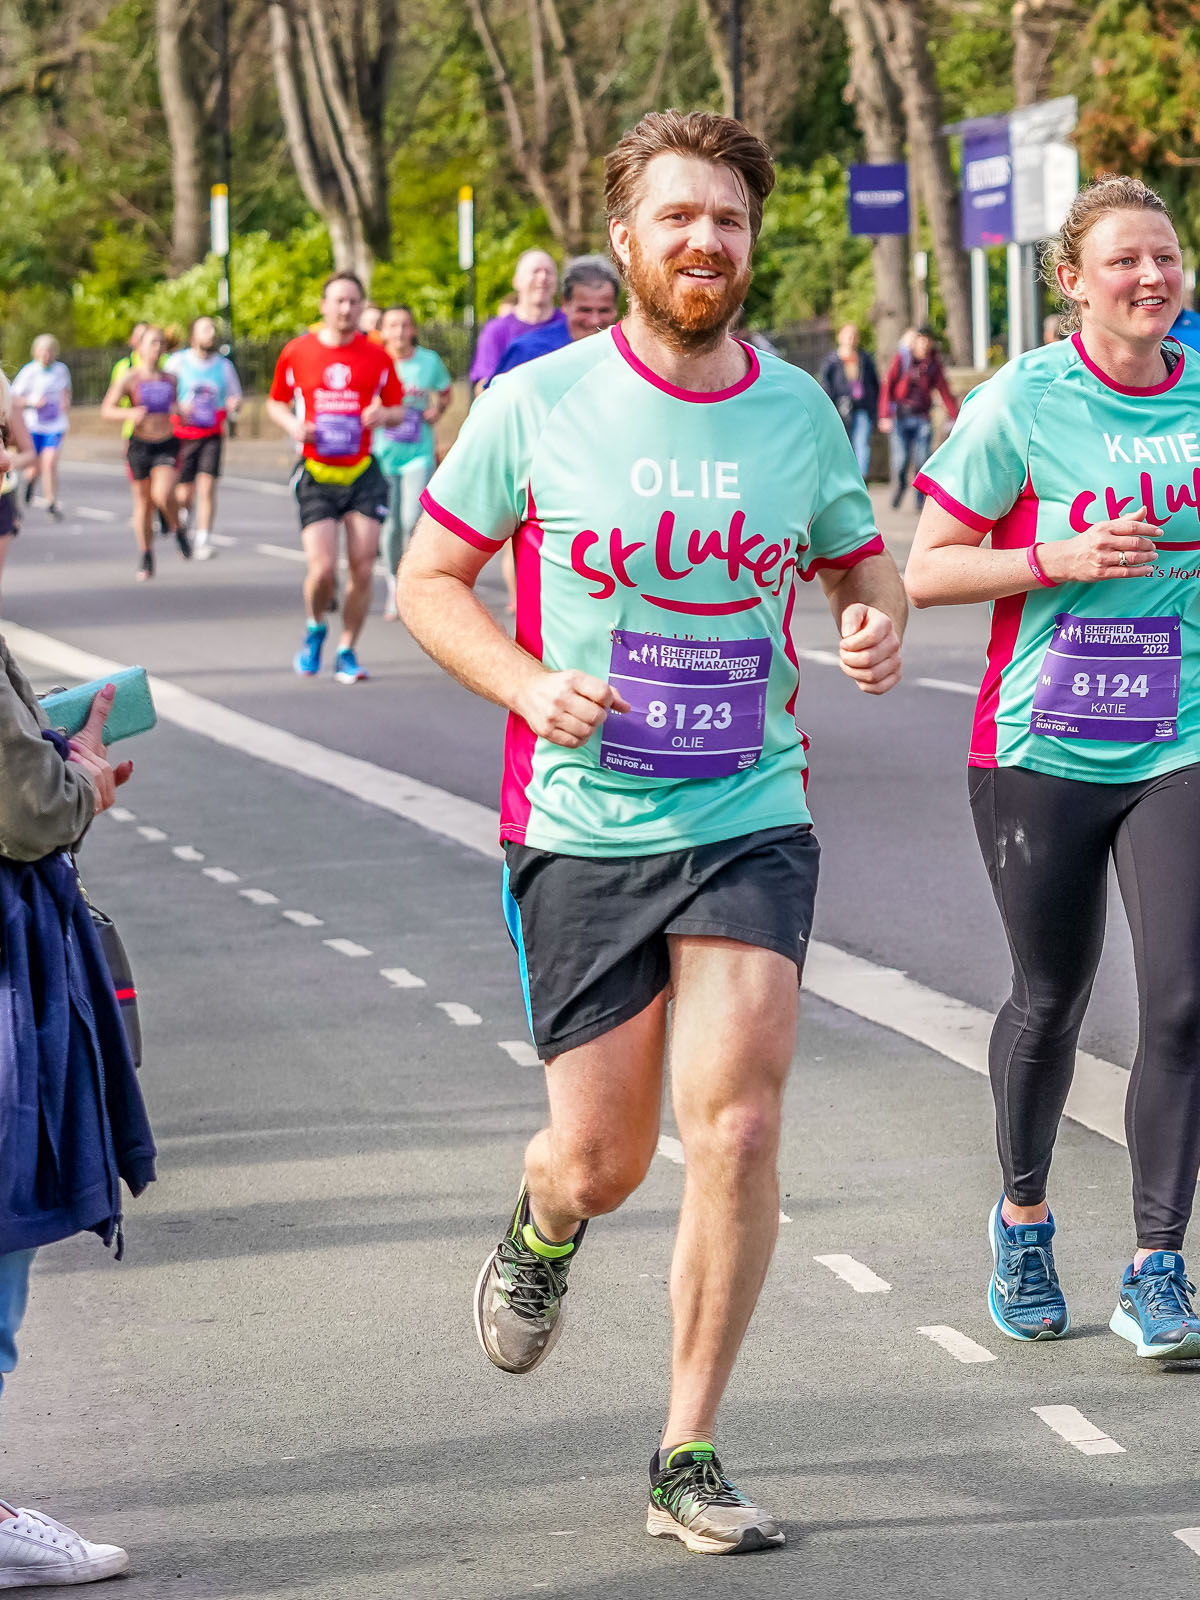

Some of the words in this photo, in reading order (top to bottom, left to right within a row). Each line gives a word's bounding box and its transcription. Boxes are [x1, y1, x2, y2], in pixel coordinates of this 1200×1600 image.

[630, 457, 741, 499] OLIE
[570, 527, 646, 600] St
[656, 510, 795, 597] Luke's
[1086, 625, 1133, 634] SHEFFIELD
[1084, 634, 1110, 643] HALF
[1111, 633, 1169, 644] MARATHON
[662, 647, 719, 659] SHEFFIELD
[1143, 645, 1169, 654] 2022
[661, 659, 692, 669] HALF
[693, 657, 759, 670] MARATHON
[728, 668, 757, 680] 2022
[1041, 675, 1051, 686] M
[1071, 672, 1149, 698] 8124
[1090, 703, 1127, 714] KATIE
[646, 700, 732, 730] 8123
[1036, 721, 1051, 730] RUN
[1052, 723, 1066, 731] FOR
[1067, 725, 1079, 733] ALL
[671, 736, 704, 749] OLIE
[606, 756, 622, 767] RUN
[623, 758, 639, 769] FOR
[639, 762, 654, 771] ALL
